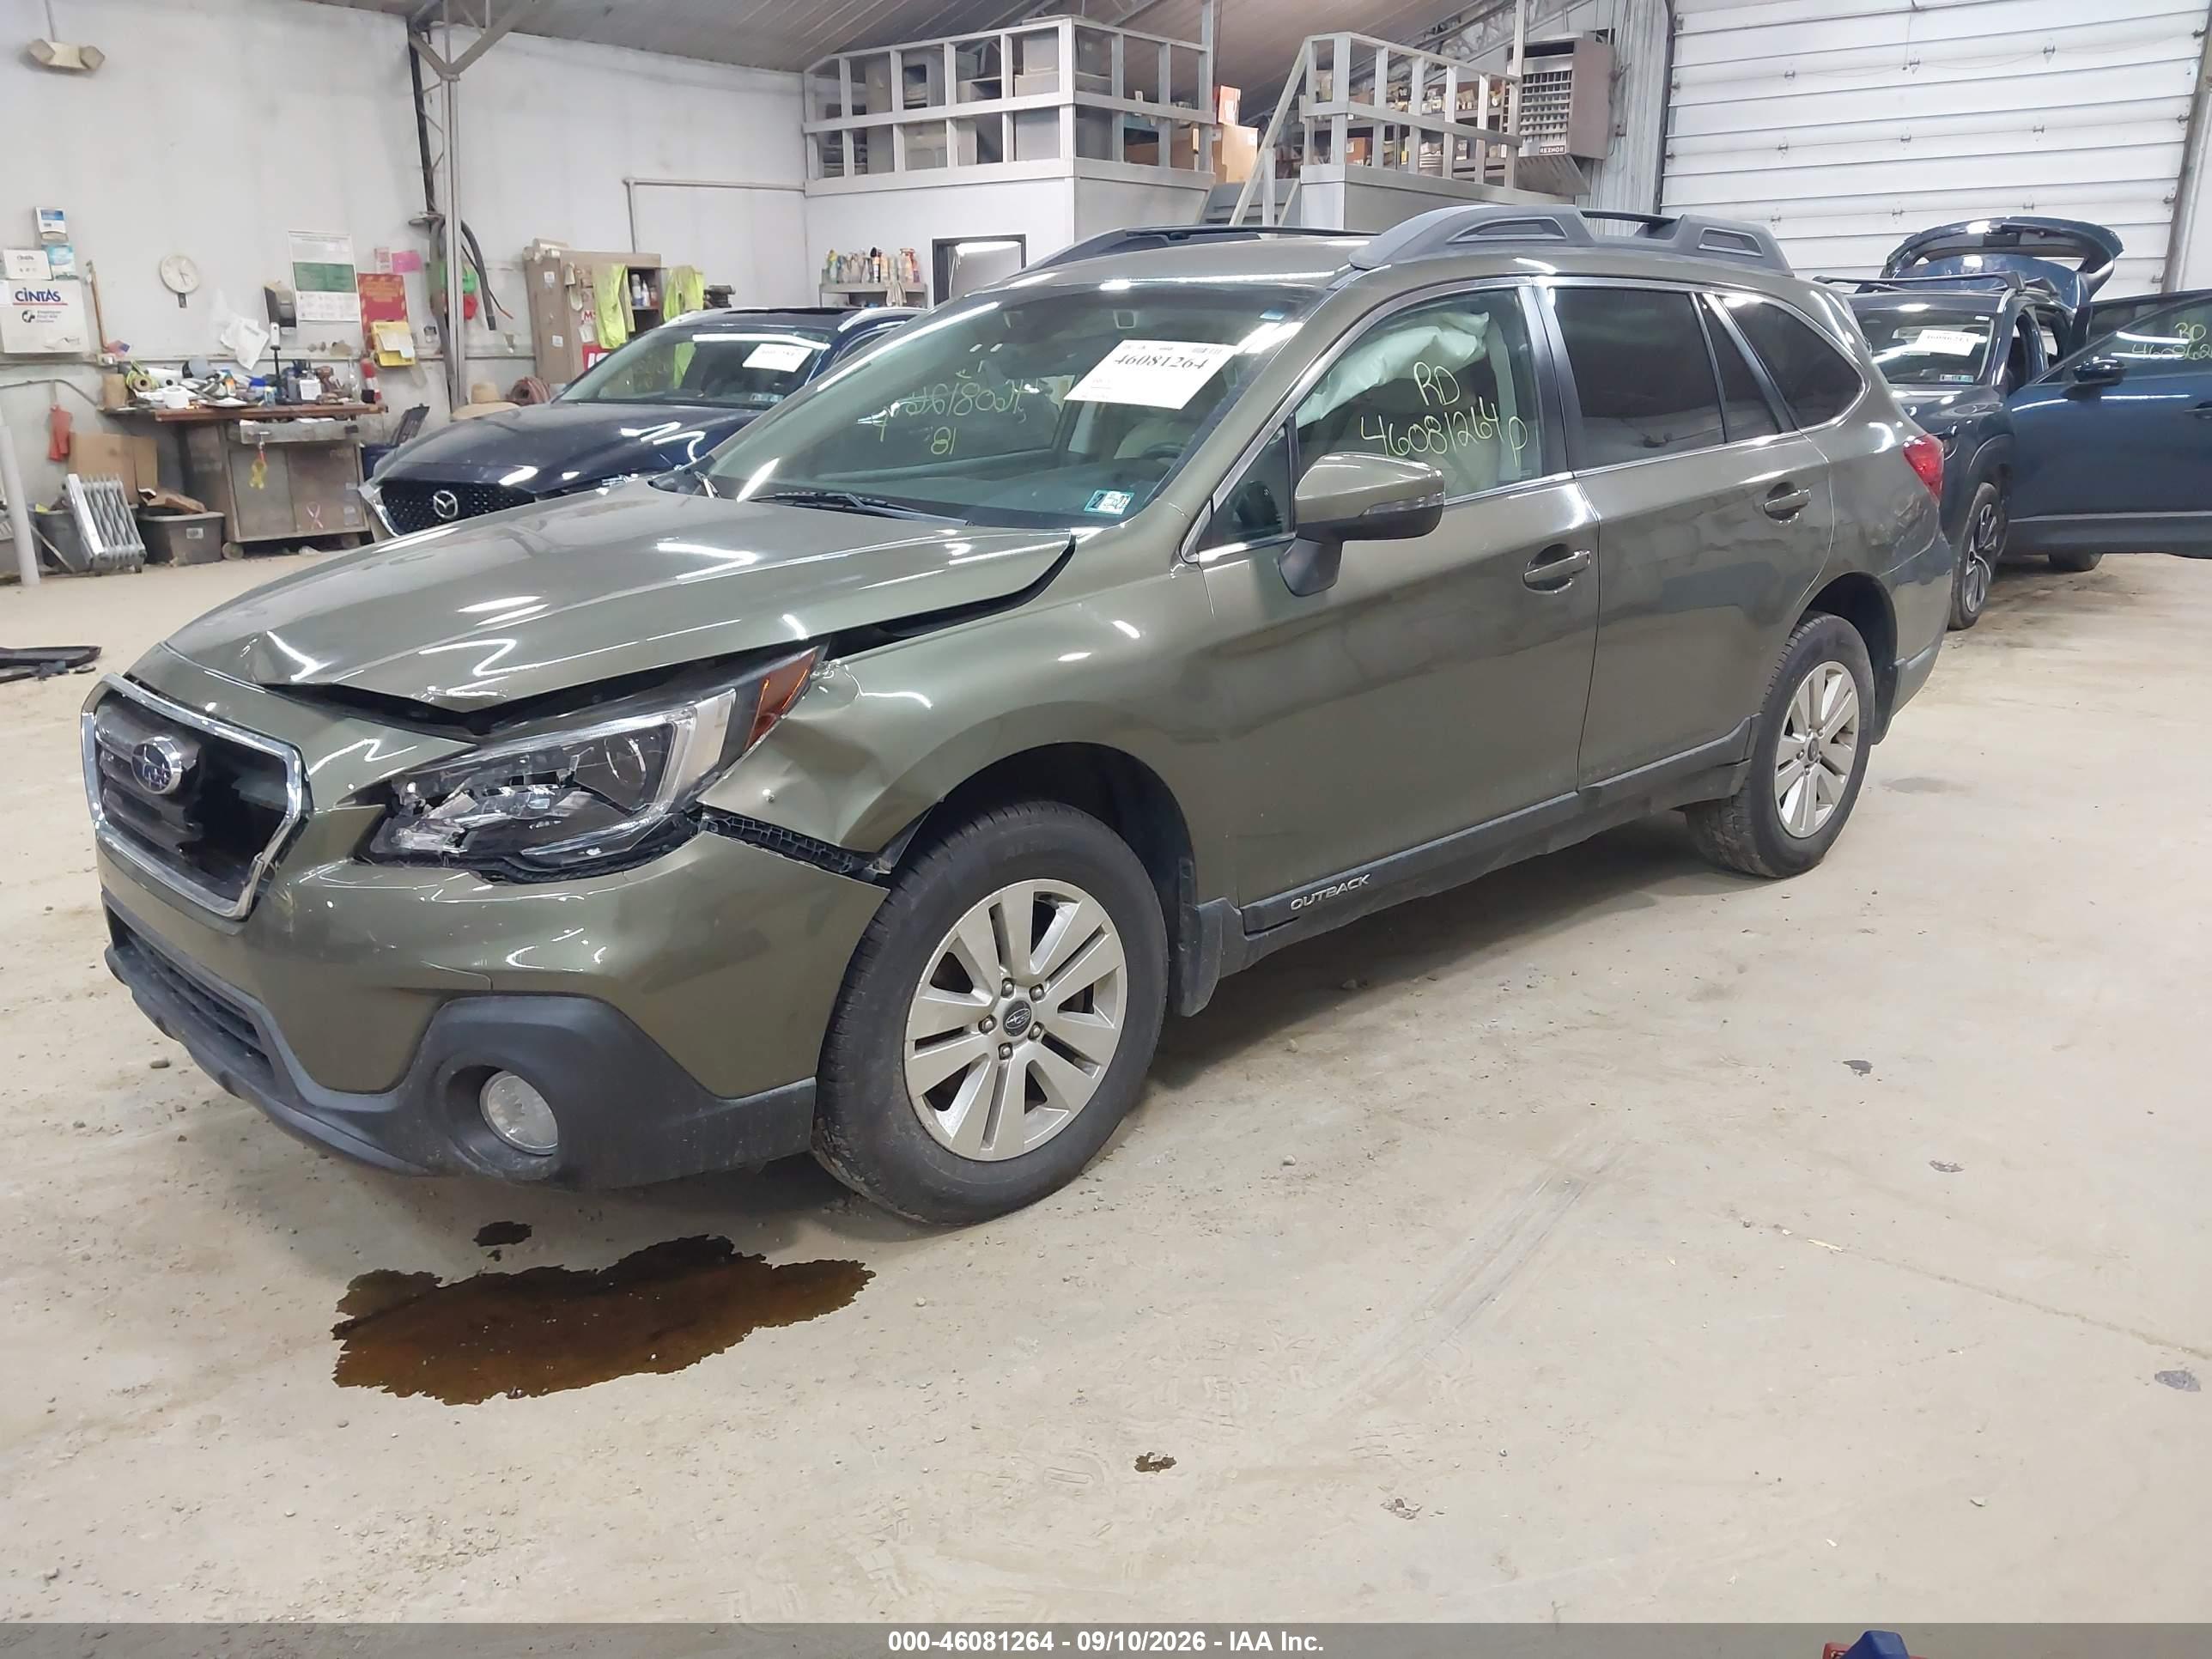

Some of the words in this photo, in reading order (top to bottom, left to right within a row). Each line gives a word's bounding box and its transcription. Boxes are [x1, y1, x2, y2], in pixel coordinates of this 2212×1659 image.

[15, 288, 61, 302] CINTAS
[1115, 354, 1209, 369] 46081264
[2131, 343, 2212, 361] 460862
[1413, 362, 1460, 405] RD
[1360, 396, 1504, 456] 46081264
[1290, 873, 1371, 910] OUTBACK
